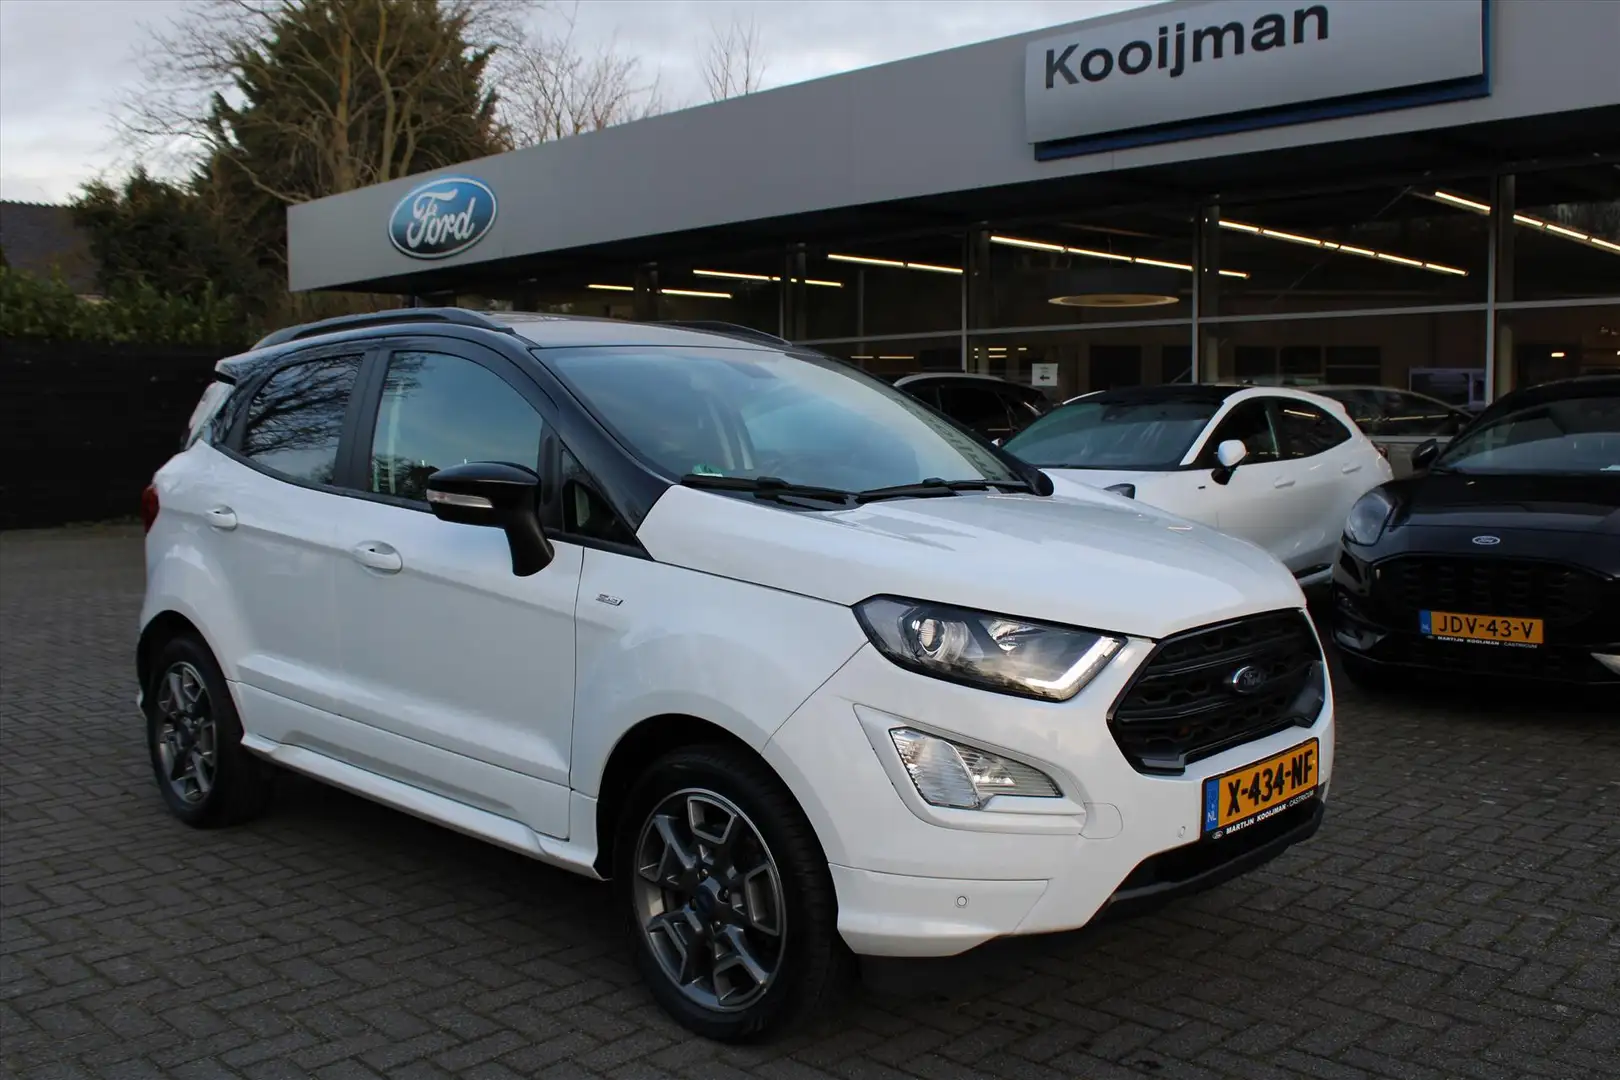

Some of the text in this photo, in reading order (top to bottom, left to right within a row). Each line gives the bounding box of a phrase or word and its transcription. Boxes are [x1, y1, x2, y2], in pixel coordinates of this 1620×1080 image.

[1045, 4, 1329, 89] Kooijman
[406, 187, 477, 249] Ford
[1438, 615, 1534, 639] JDV-43-V
[1227, 749, 1313, 817] X-434-NF
[1207, 811, 1217, 822] NL
[1226, 818, 1255, 835] MARTIJN
[1256, 803, 1286, 822] KOOIJMAN
